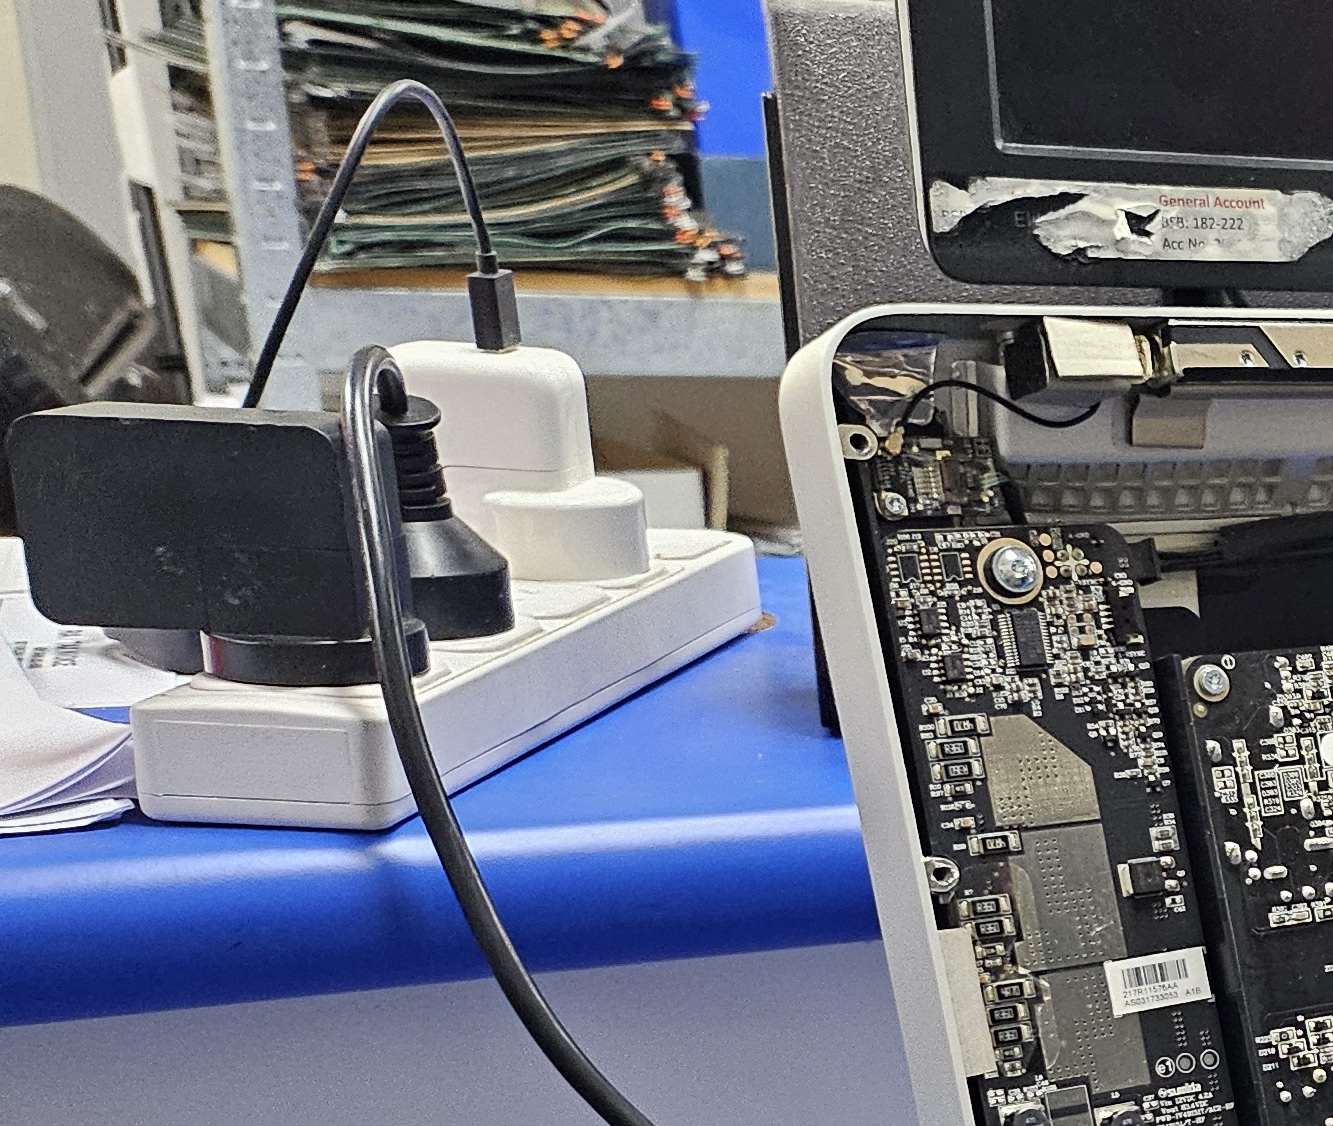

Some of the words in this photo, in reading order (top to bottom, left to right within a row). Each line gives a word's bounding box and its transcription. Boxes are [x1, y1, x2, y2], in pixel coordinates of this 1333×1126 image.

[1159, 195, 1210, 208] General
[1214, 196, 1265, 209] Account
[1194, 217, 1245, 230] 182-222
[1162, 238, 1184, 250] Acc
[1157, 1060, 1173, 1074] e1
